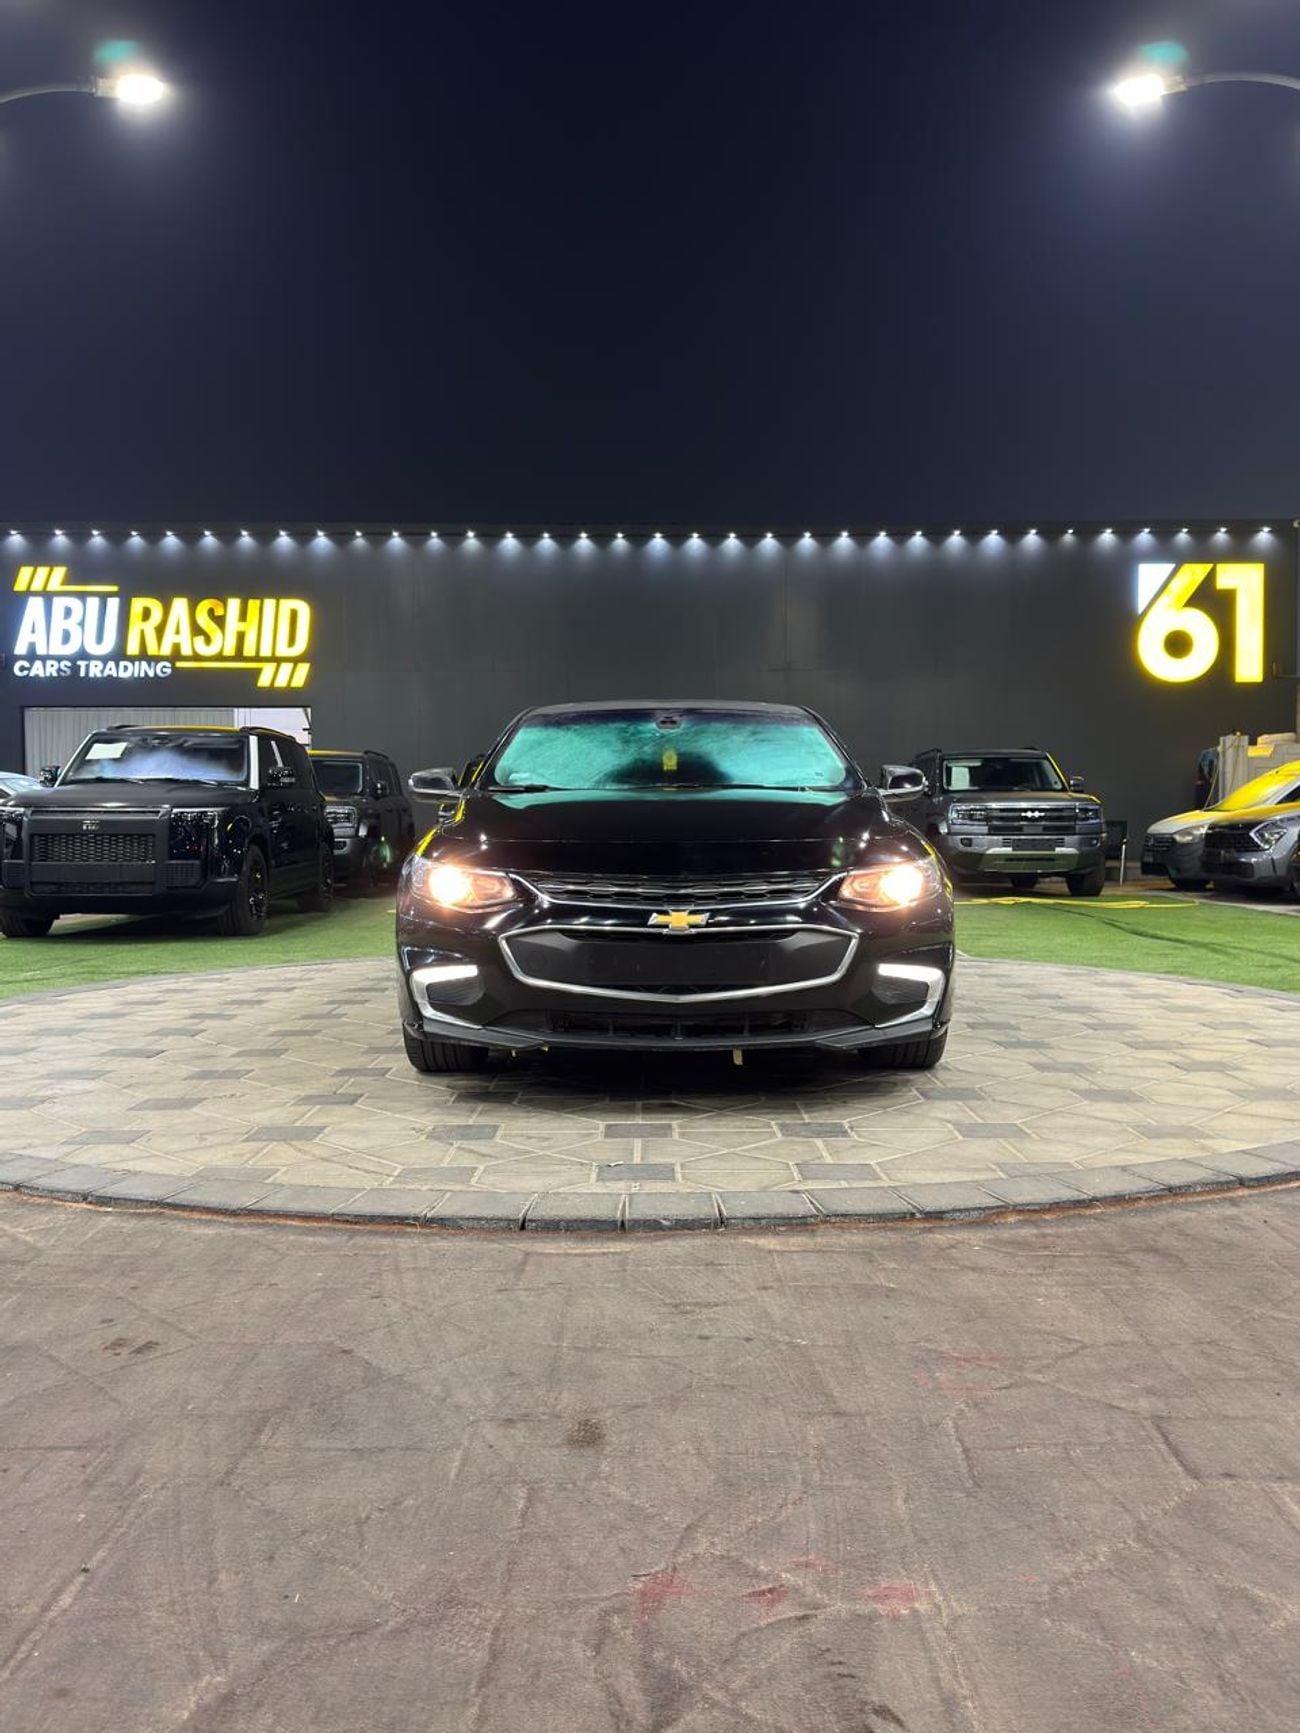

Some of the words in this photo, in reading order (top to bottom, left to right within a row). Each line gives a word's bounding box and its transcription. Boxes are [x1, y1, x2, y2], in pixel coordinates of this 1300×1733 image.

[14, 597, 120, 656] ABU
[126, 597, 311, 657] RASHID
[1138, 563, 1265, 683] 61
[13, 660, 71, 677] CARS
[76, 660, 172, 678] TRADING
